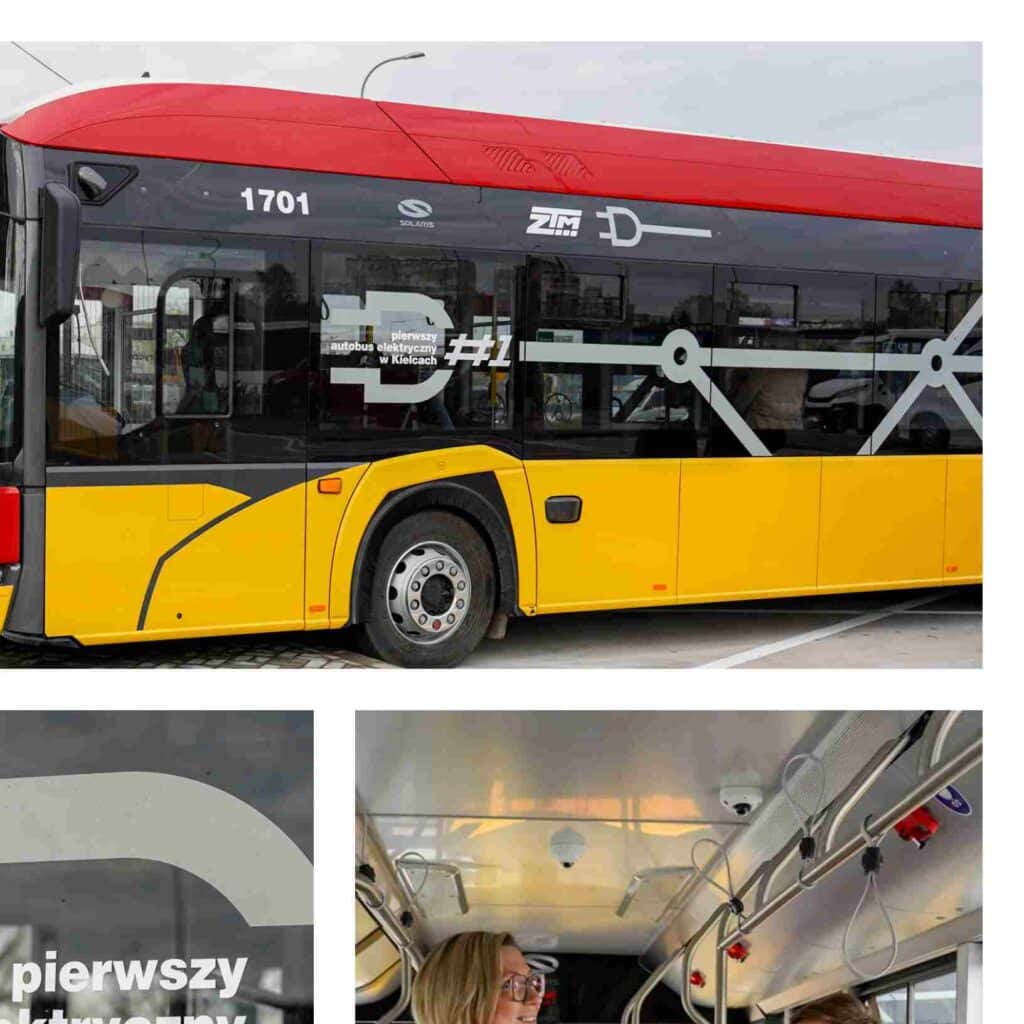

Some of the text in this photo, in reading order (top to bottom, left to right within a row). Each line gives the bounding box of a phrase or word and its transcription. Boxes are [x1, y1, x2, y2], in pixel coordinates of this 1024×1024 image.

[240, 187, 310, 215] 1701
[526, 206, 583, 237] ZTM
[330, 341, 437, 355] autobus elektryczny
[391, 330, 437, 342] pierwszy
[444, 333, 513, 367] #1
[379, 355, 437, 365] w Kielcach
[12, 950, 248, 1002] pierwszy
